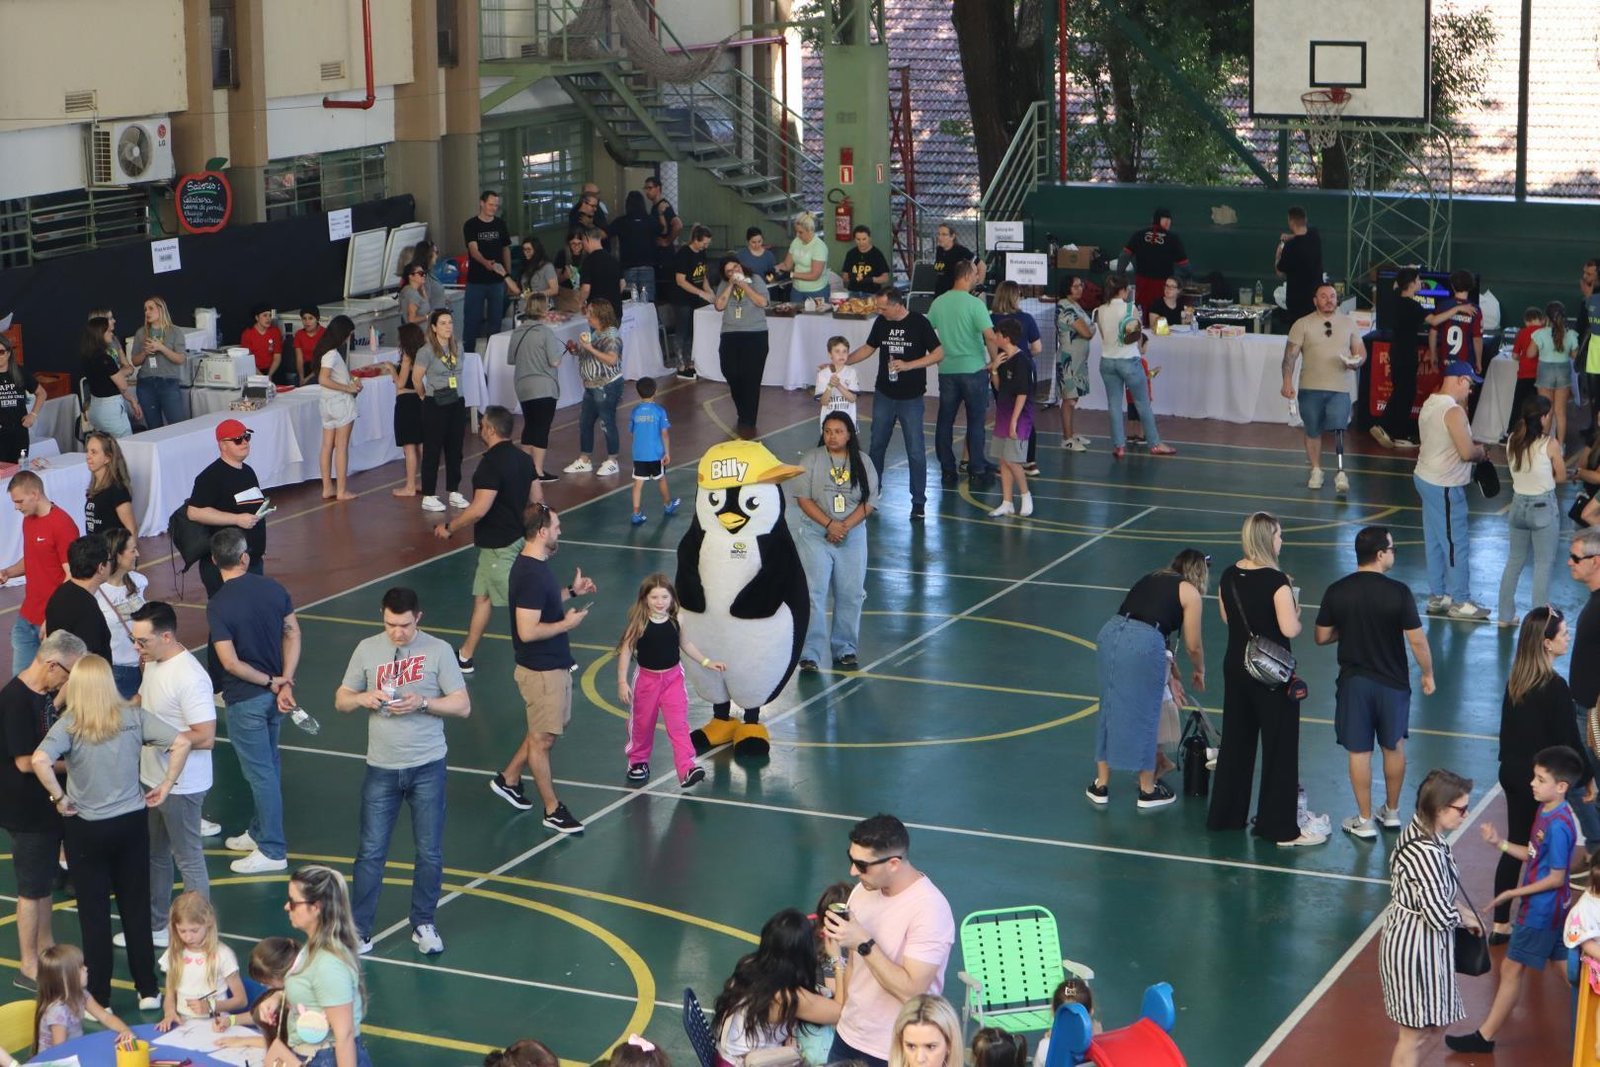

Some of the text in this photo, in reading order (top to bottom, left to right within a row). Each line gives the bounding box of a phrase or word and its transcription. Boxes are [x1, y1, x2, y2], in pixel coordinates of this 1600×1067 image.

[851, 264, 872, 275] APP
[889, 328, 905, 336] APP
[1446, 325, 1463, 355] 9
[711, 457, 748, 482] Billy
[376, 654, 426, 691] NIKE
